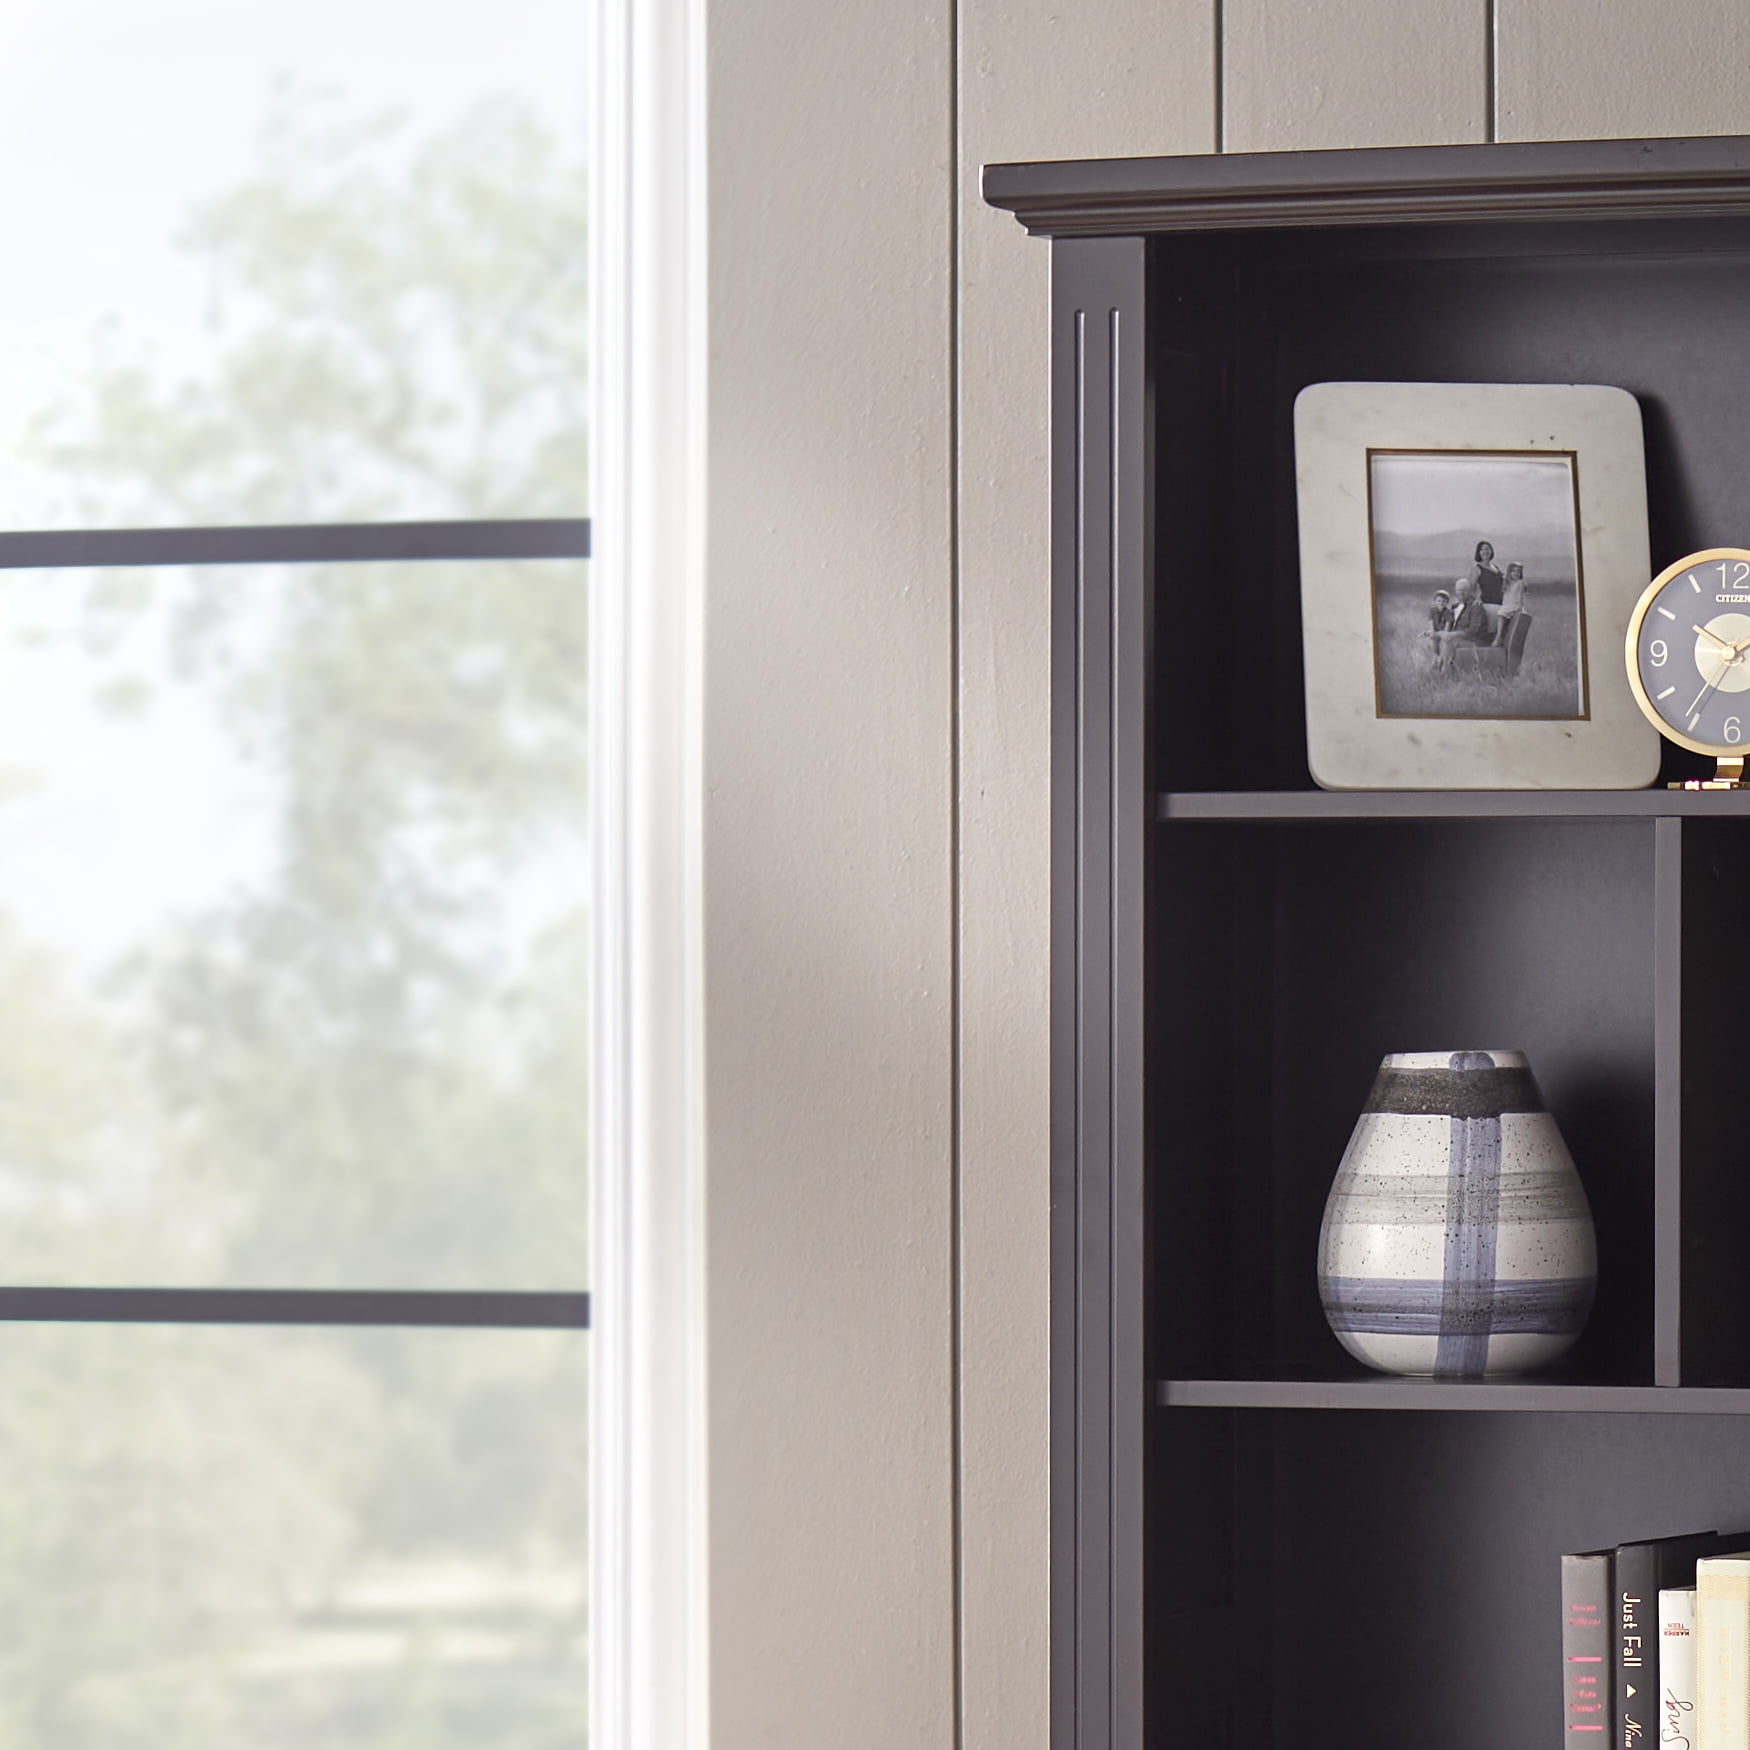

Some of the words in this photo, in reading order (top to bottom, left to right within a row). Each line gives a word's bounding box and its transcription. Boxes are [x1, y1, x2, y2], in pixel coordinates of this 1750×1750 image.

[1716, 562, 1750, 589] 12
[1715, 594, 1750, 603] CITIZEN
[1650, 639, 1668, 667] 9
[1723, 716, 1741, 743] 6
[1622, 1592, 1641, 1629] Just
[1623, 1636, 1642, 1667] Fall
[1624, 1713, 1643, 1748] Nina
